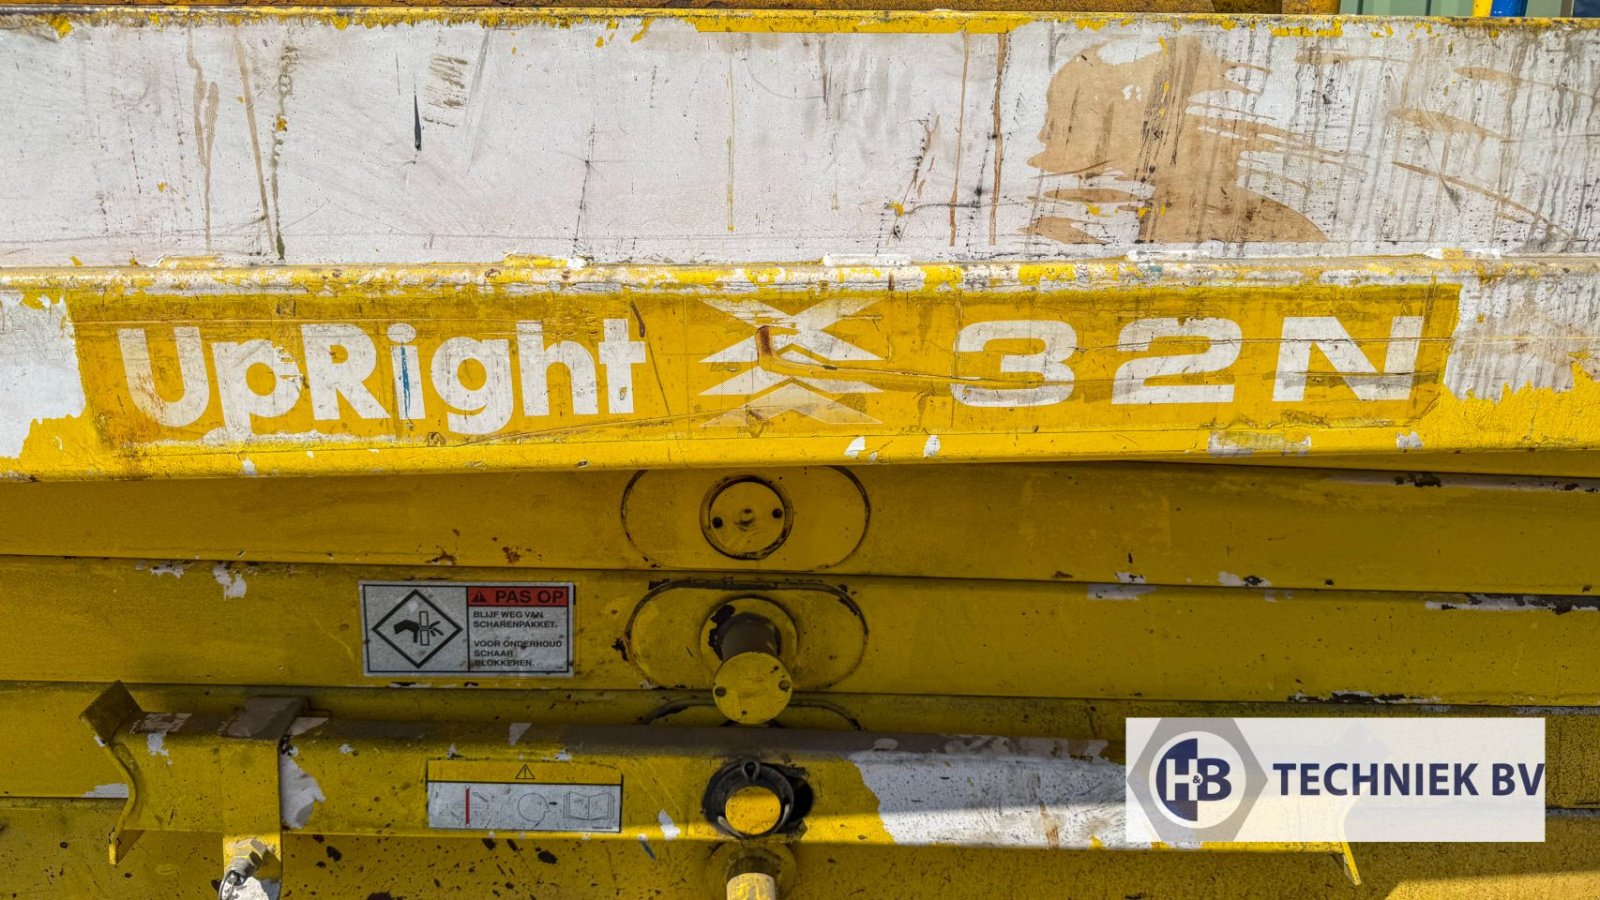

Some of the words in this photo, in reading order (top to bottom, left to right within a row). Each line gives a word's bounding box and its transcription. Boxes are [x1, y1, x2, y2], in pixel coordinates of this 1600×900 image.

[117, 318, 646, 441] UpRight
[950, 316, 1423, 407] 32N
[495, 590, 532, 603] PAS
[537, 590, 563, 603] OP
[474, 640, 501, 648] VOOR
[502, 640, 563, 648] ONDERHOUD
